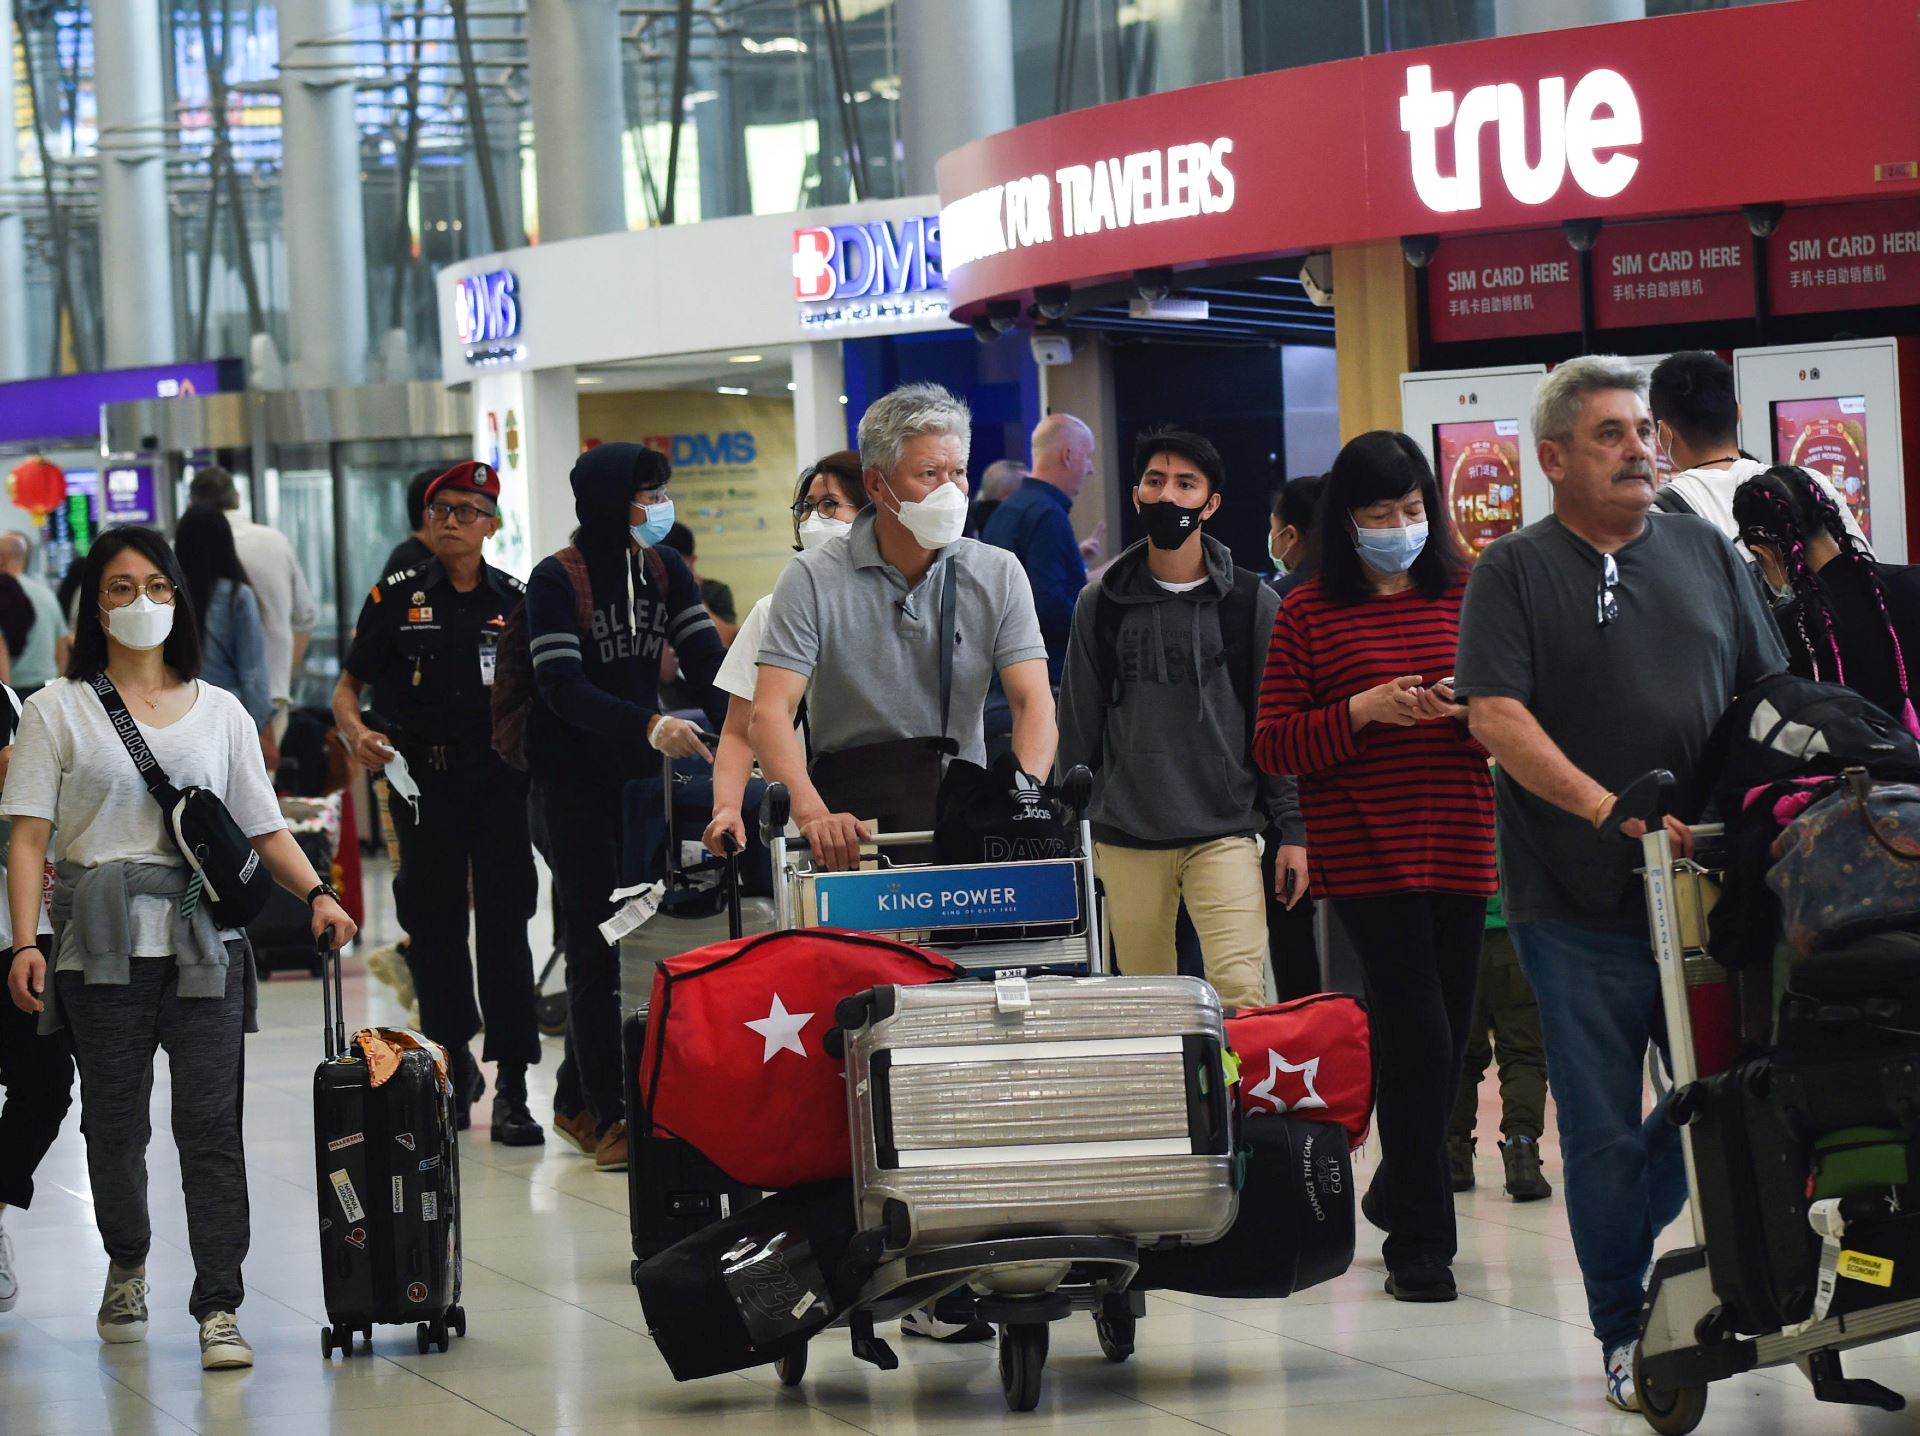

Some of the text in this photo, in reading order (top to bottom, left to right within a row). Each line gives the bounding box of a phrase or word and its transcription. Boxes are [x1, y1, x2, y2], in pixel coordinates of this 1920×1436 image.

[1399, 64, 1642, 212] true
[1005, 174, 1052, 250] FOR
[1055, 137, 1235, 237] TRAVELERS
[1612, 246, 1741, 276] SIM CARD HERE
[1789, 238, 1821, 262] SIM
[1827, 235, 1876, 258] CARD
[1448, 262, 1569, 292] SIM CARD HERE
[1790, 264, 1886, 288] 手机卡自助销售机
[1613, 279, 1704, 301] 手机卡自助销售机
[1449, 294, 1534, 316] 手机卡自助销售机
[109, 708, 156, 772] DISCOVERY
[1012, 805, 1051, 820] adidas
[878, 887, 1016, 911] KING POWER
[1001, 969, 1022, 977] BKK
[1303, 1158, 1313, 1179] THE
[1328, 1156, 1342, 1194] GOLF
[338, 1185, 356, 1219] GEOGRAPHIC
[344, 1183, 359, 1209] NATIONAL
[1306, 1181, 1325, 1221] CHANGE
[1847, 1263, 1880, 1277] ECONOMY
[1848, 1255, 1881, 1269] PREMIUM
